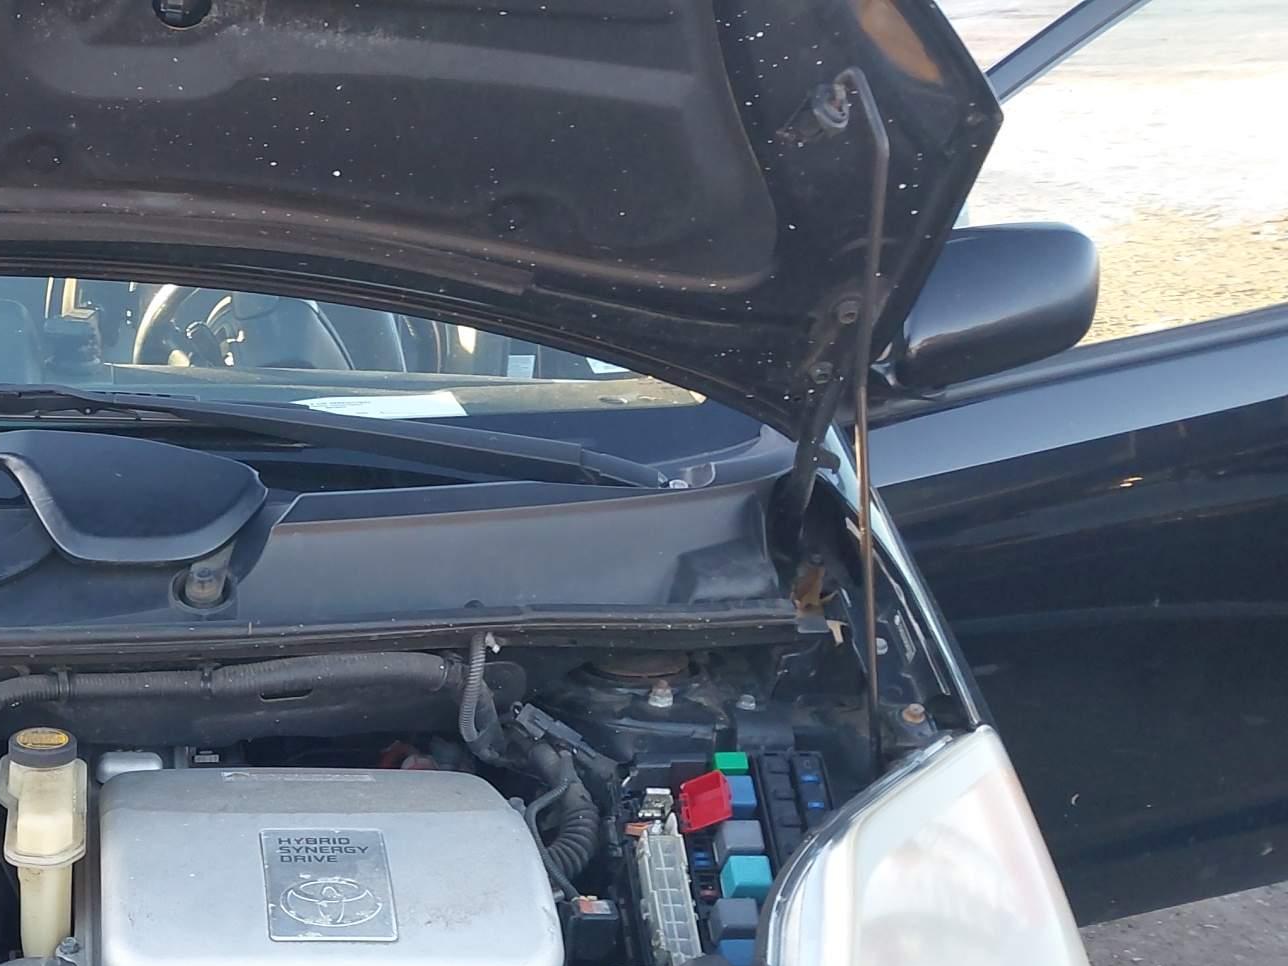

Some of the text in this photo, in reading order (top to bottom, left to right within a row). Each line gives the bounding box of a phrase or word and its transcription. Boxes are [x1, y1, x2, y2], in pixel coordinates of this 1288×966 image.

[278, 837, 351, 845] HYBRID
[279, 846, 369, 854] SYNERGY
[280, 855, 338, 863] DRIVE
